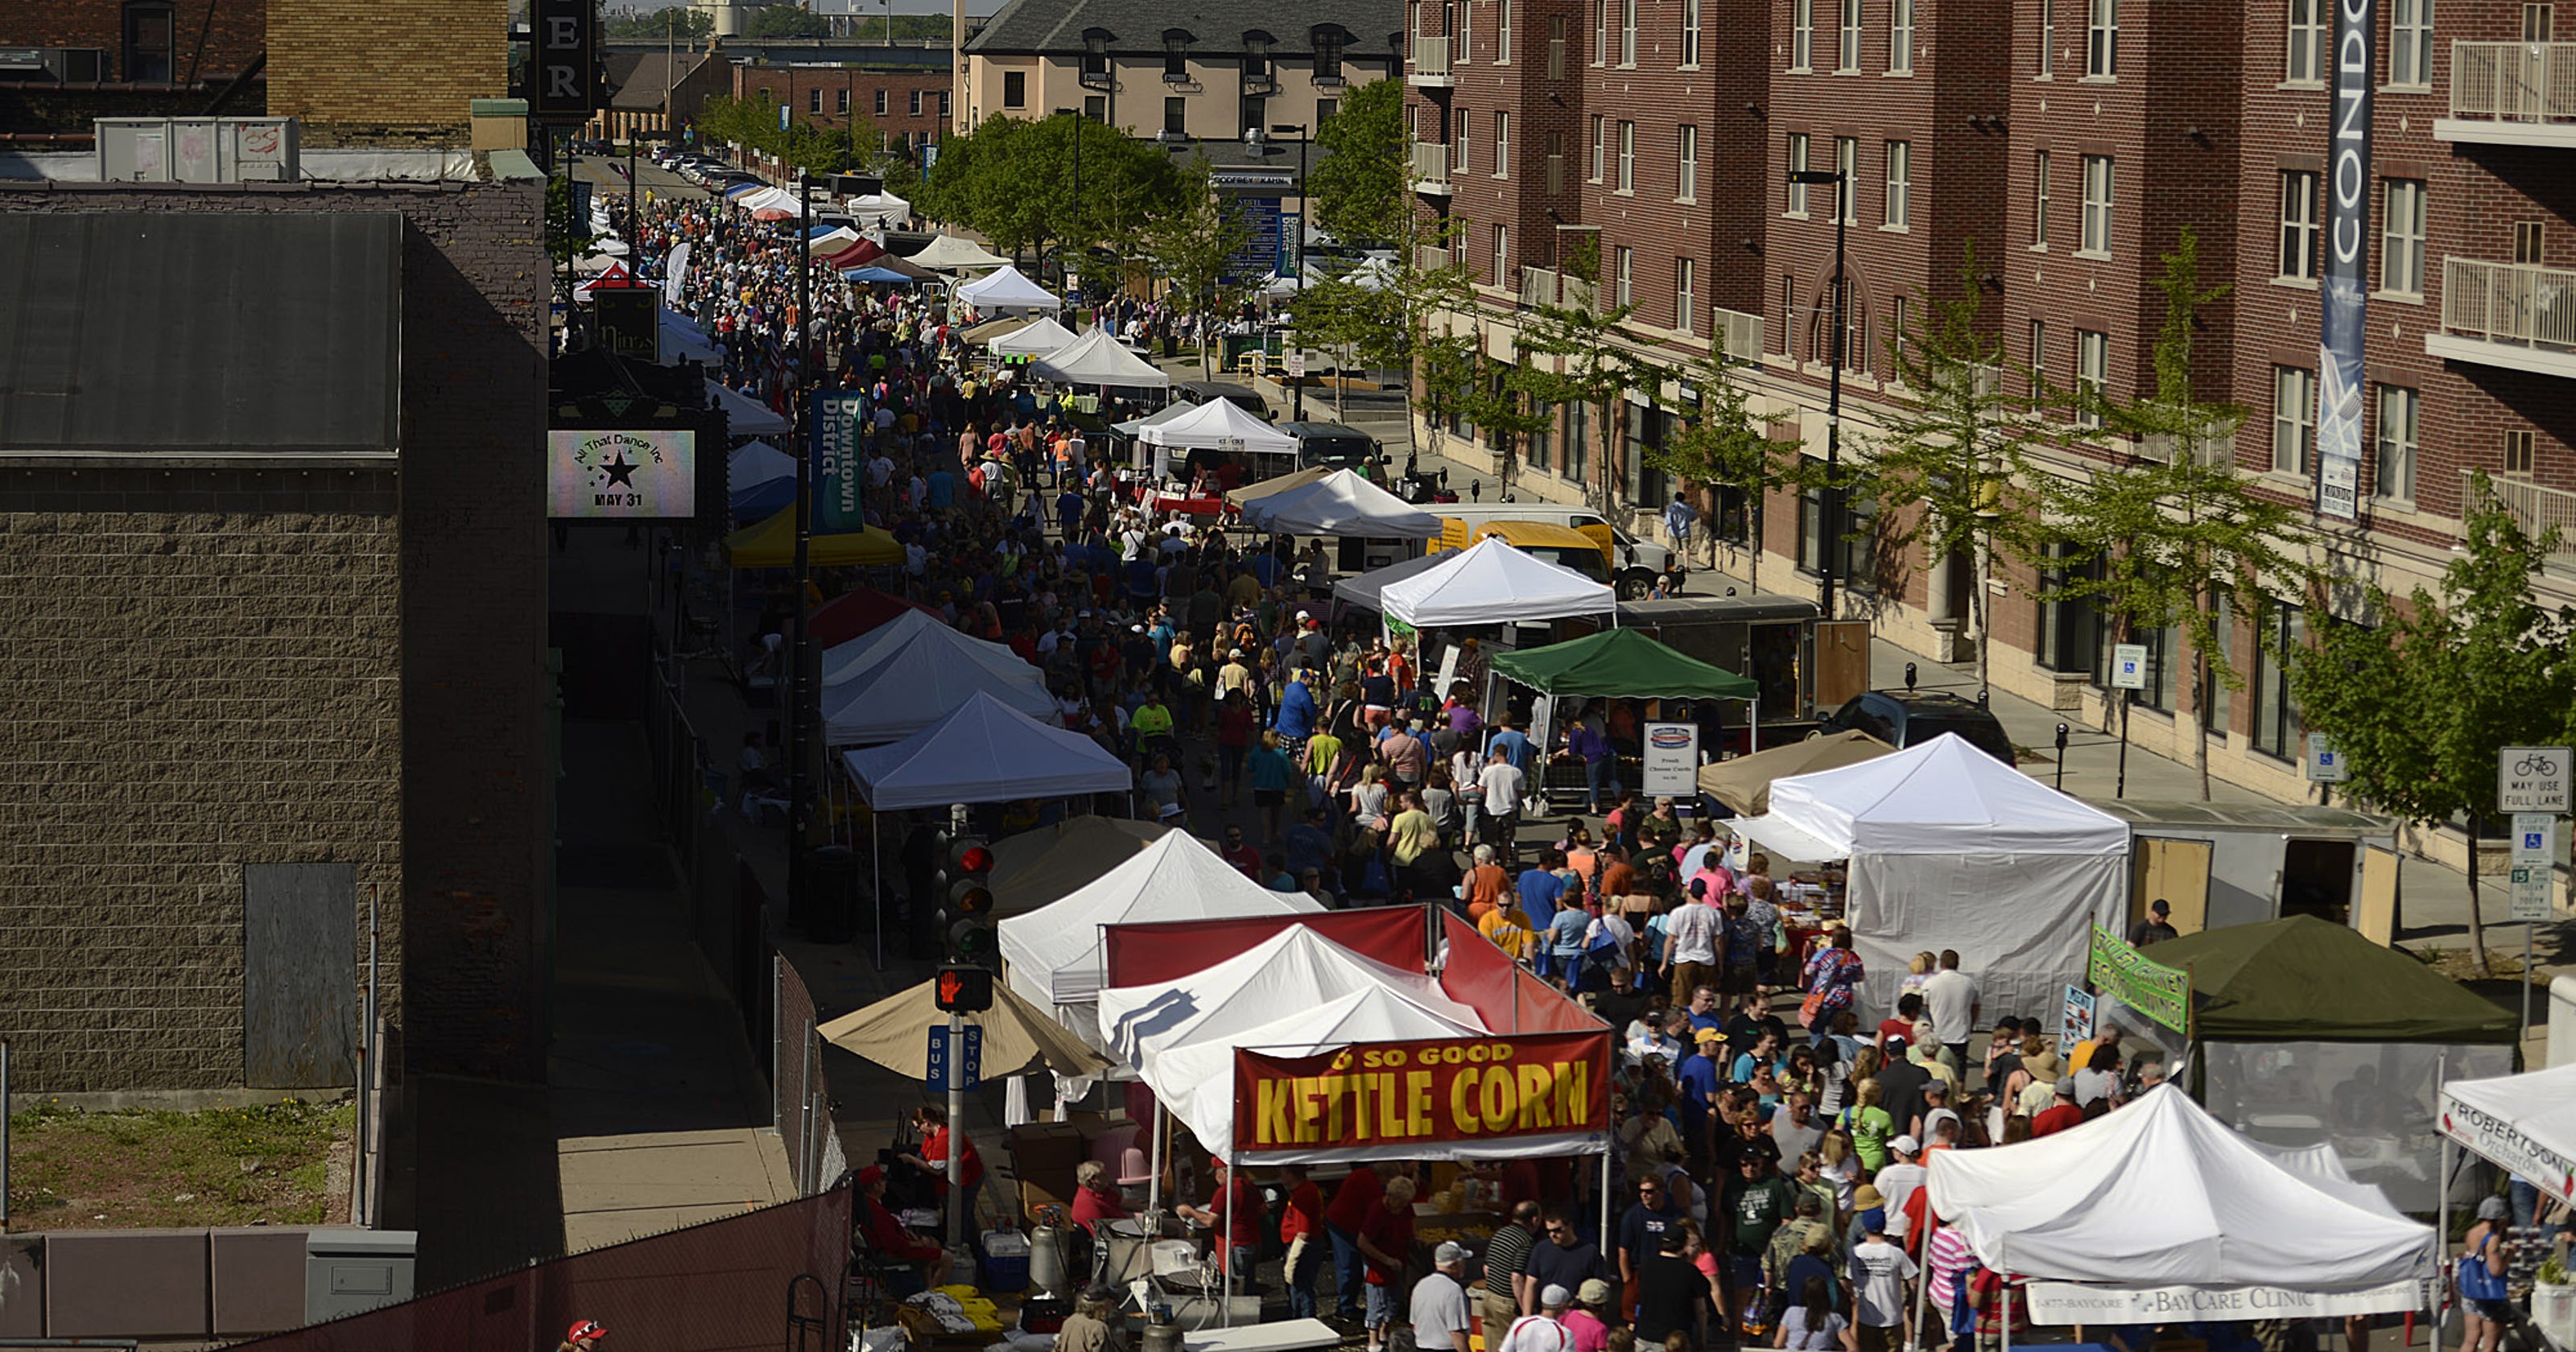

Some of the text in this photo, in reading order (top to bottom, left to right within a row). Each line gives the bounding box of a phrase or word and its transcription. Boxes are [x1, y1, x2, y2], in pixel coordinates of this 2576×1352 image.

[546, 0, 580, 97] ER
[1290, 217, 1298, 268] Downtown
[574, 434, 663, 464] All That Dance Inc
[822, 400, 840, 476] District
[841, 400, 859, 513] Downtown
[595, 493, 642, 507] MAY 31
[2505, 796, 2564, 805] FULL LANE
[2512, 781, 2559, 791] MAY USE
[2514, 872, 2527, 881] 15
[930, 1038, 941, 1079] BUS
[965, 1031, 978, 1086] STOP
[1364, 1049, 1407, 1067] SO
[1418, 1044, 1514, 1066] GOOD
[1257, 1061, 1587, 1144] KETTLE CORN
[2458, 1103, 2564, 1173] ROBERTSON
